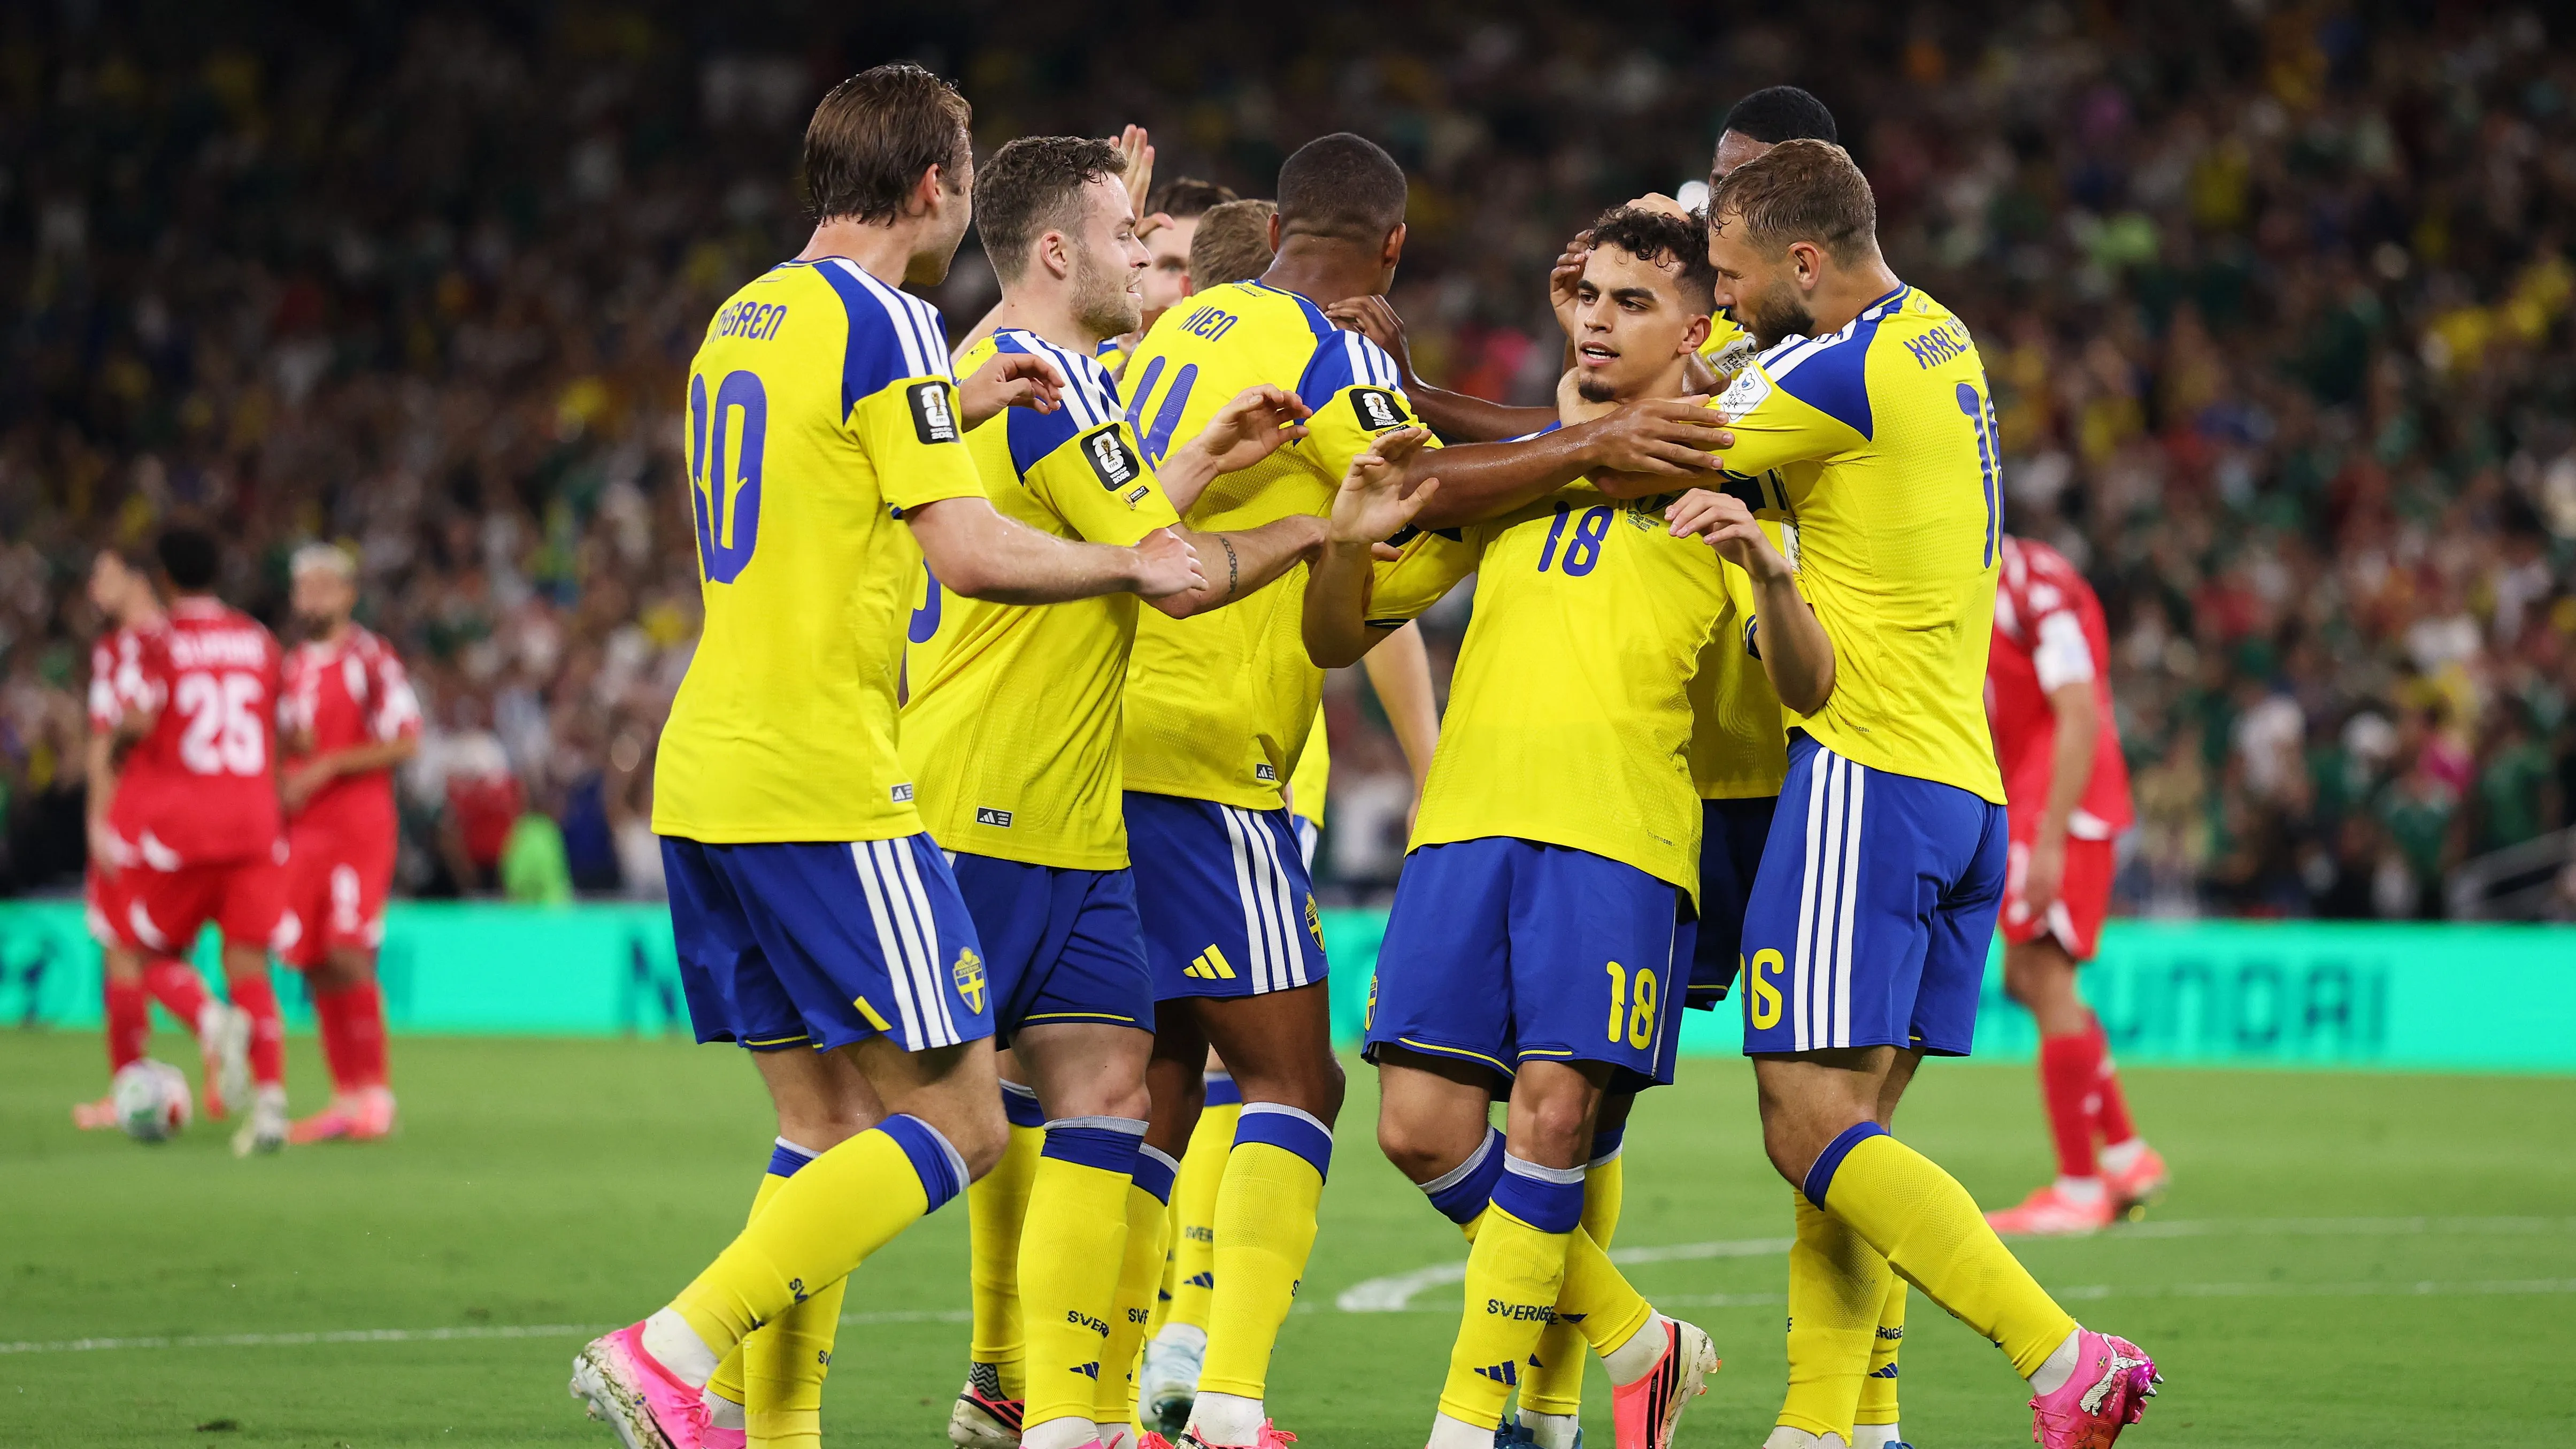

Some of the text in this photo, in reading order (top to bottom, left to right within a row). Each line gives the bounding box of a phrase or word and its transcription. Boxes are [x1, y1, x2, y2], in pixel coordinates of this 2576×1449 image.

[1178, 306, 1238, 342] HIEN
[691, 370, 767, 584] 10
[1112, 470, 1131, 485] 2026
[1537, 501, 1614, 577] 18
[1606, 961, 1657, 1050] 18
